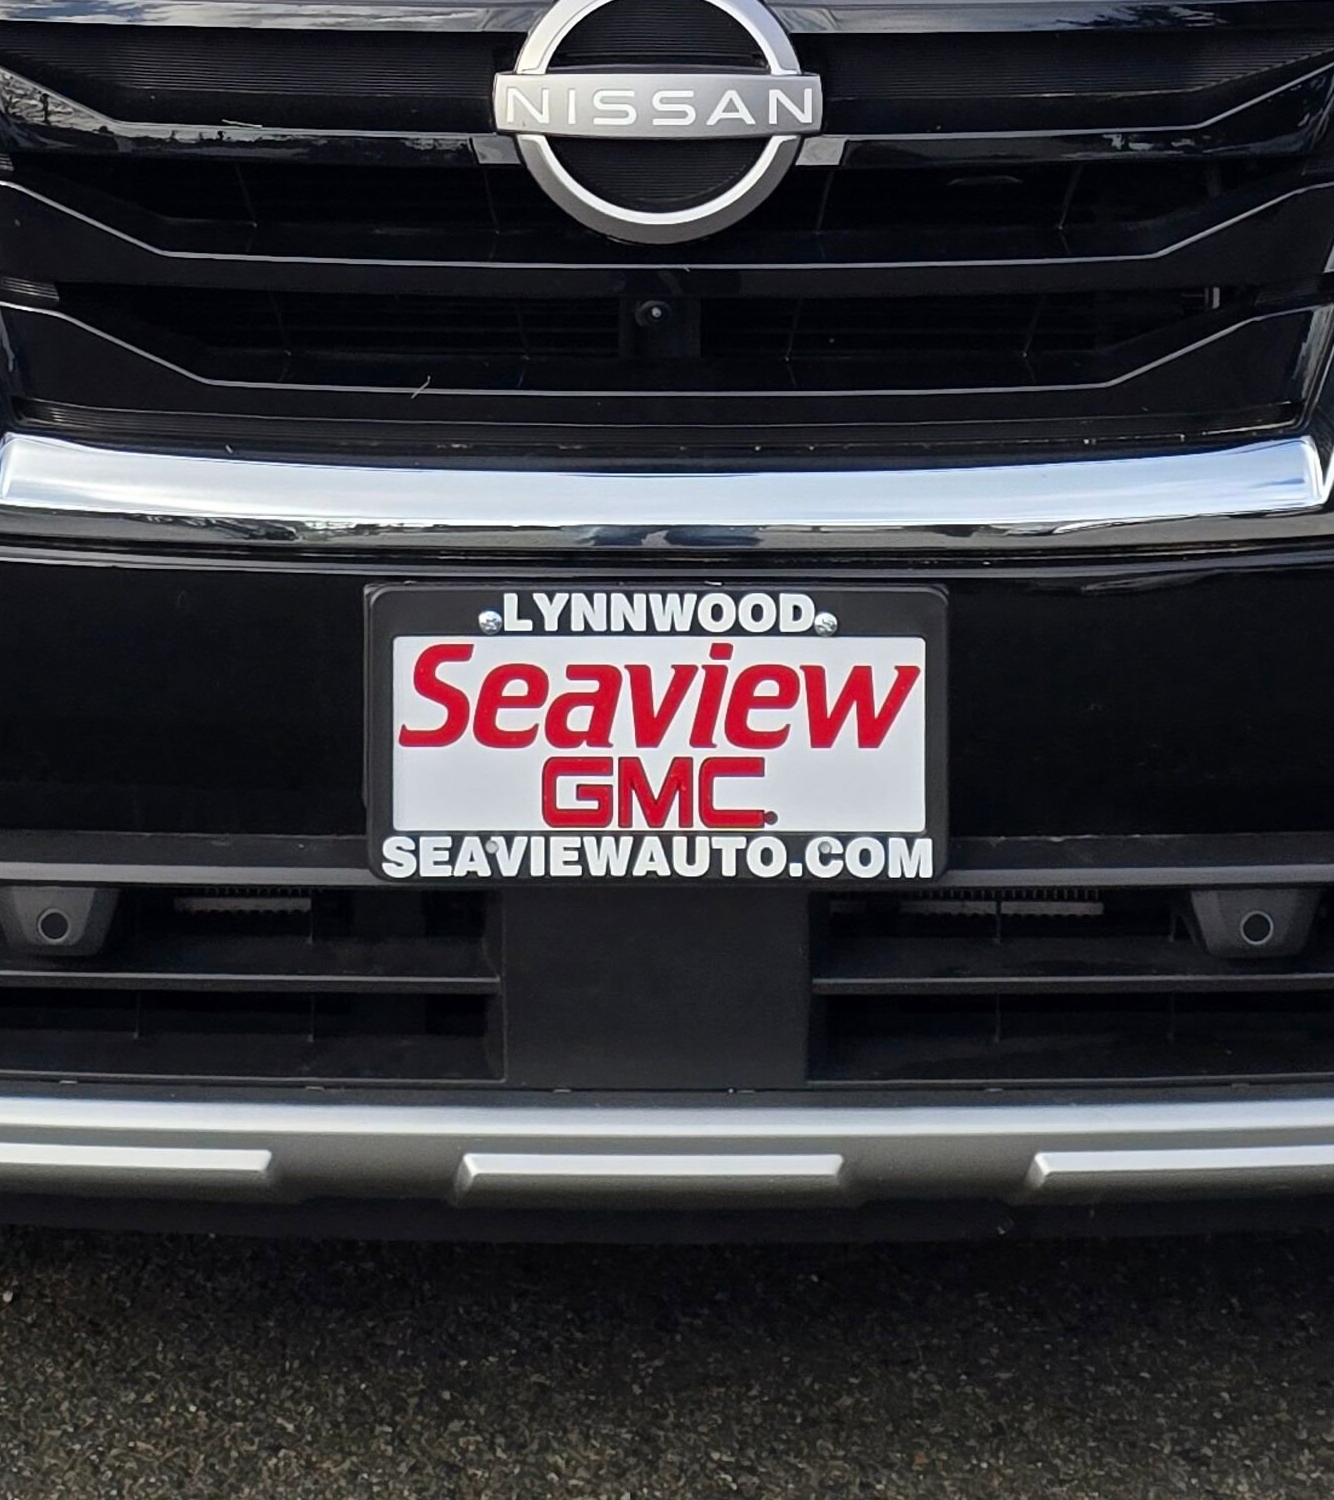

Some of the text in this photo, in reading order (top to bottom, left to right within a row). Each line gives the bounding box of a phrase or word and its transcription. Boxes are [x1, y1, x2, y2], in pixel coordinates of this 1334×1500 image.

[506, 88, 813, 126] NISSAN
[504, 593, 816, 633] LYNNWOOD
[399, 643, 920, 749] Seaview
[542, 756, 767, 828] GMC
[382, 836, 933, 878] SEAVIEWAUTO.COM
